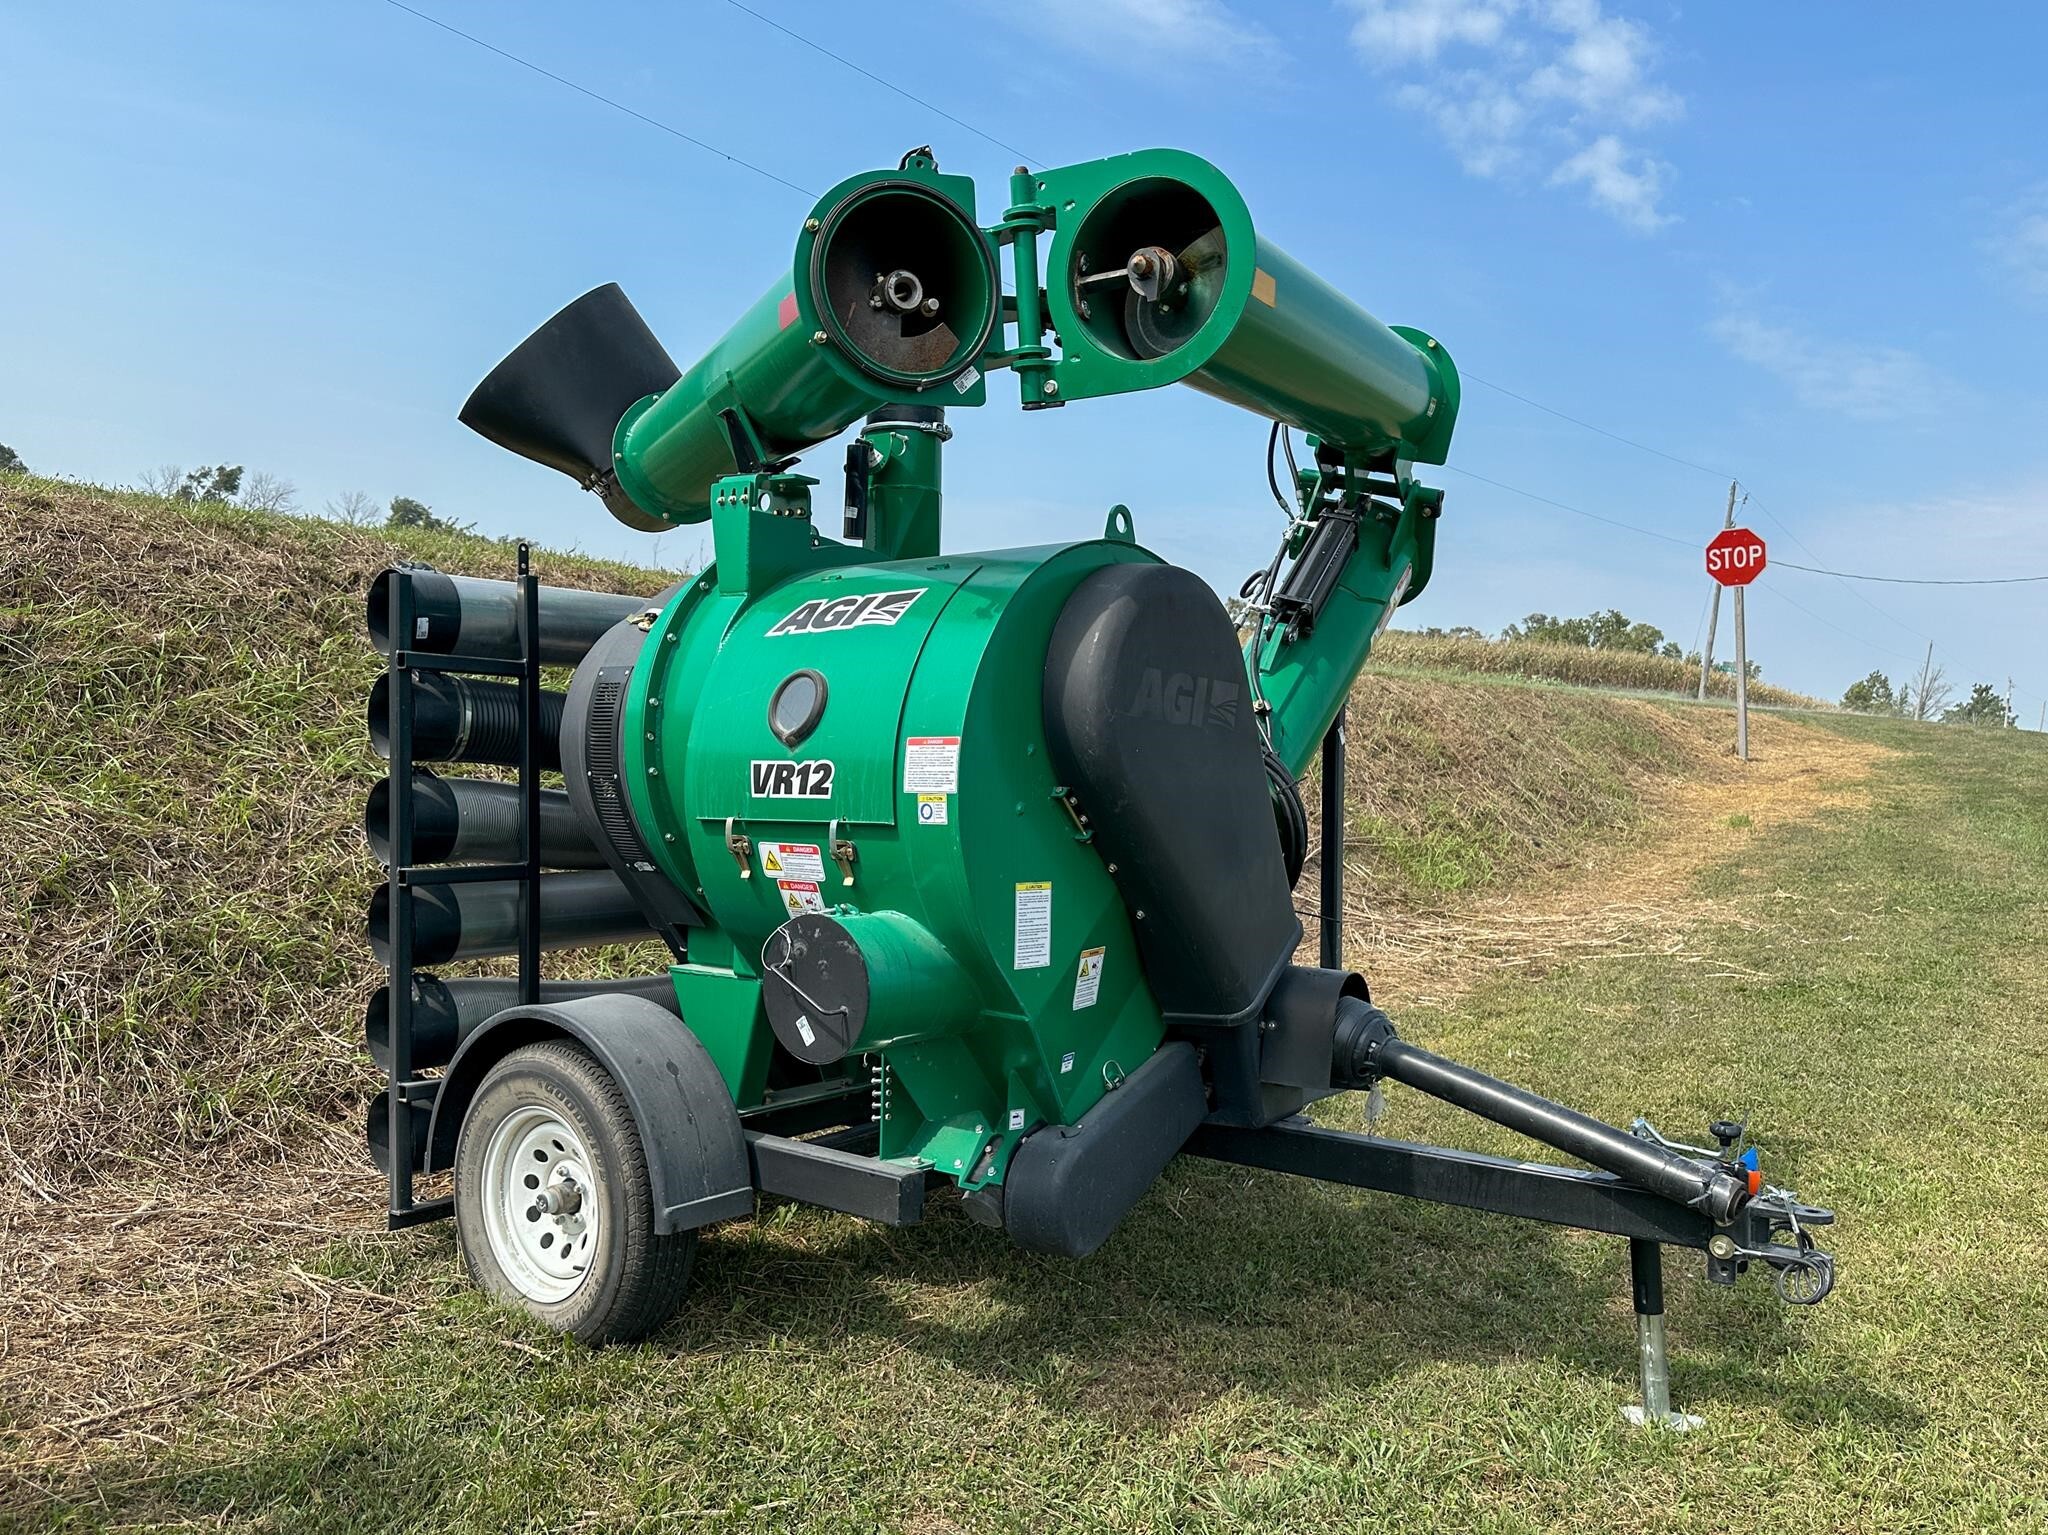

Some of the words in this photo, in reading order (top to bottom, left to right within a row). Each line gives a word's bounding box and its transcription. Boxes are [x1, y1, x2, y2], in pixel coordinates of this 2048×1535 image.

[1708, 544, 1763, 571] STOP
[771, 595, 879, 633] AGI
[1129, 666, 1208, 728] AGI
[752, 762, 833, 796] VR12
[792, 845, 814, 853] DANGER
[789, 882, 815, 891] DANGER
[544, 1081, 608, 1182] GOODRIDE
